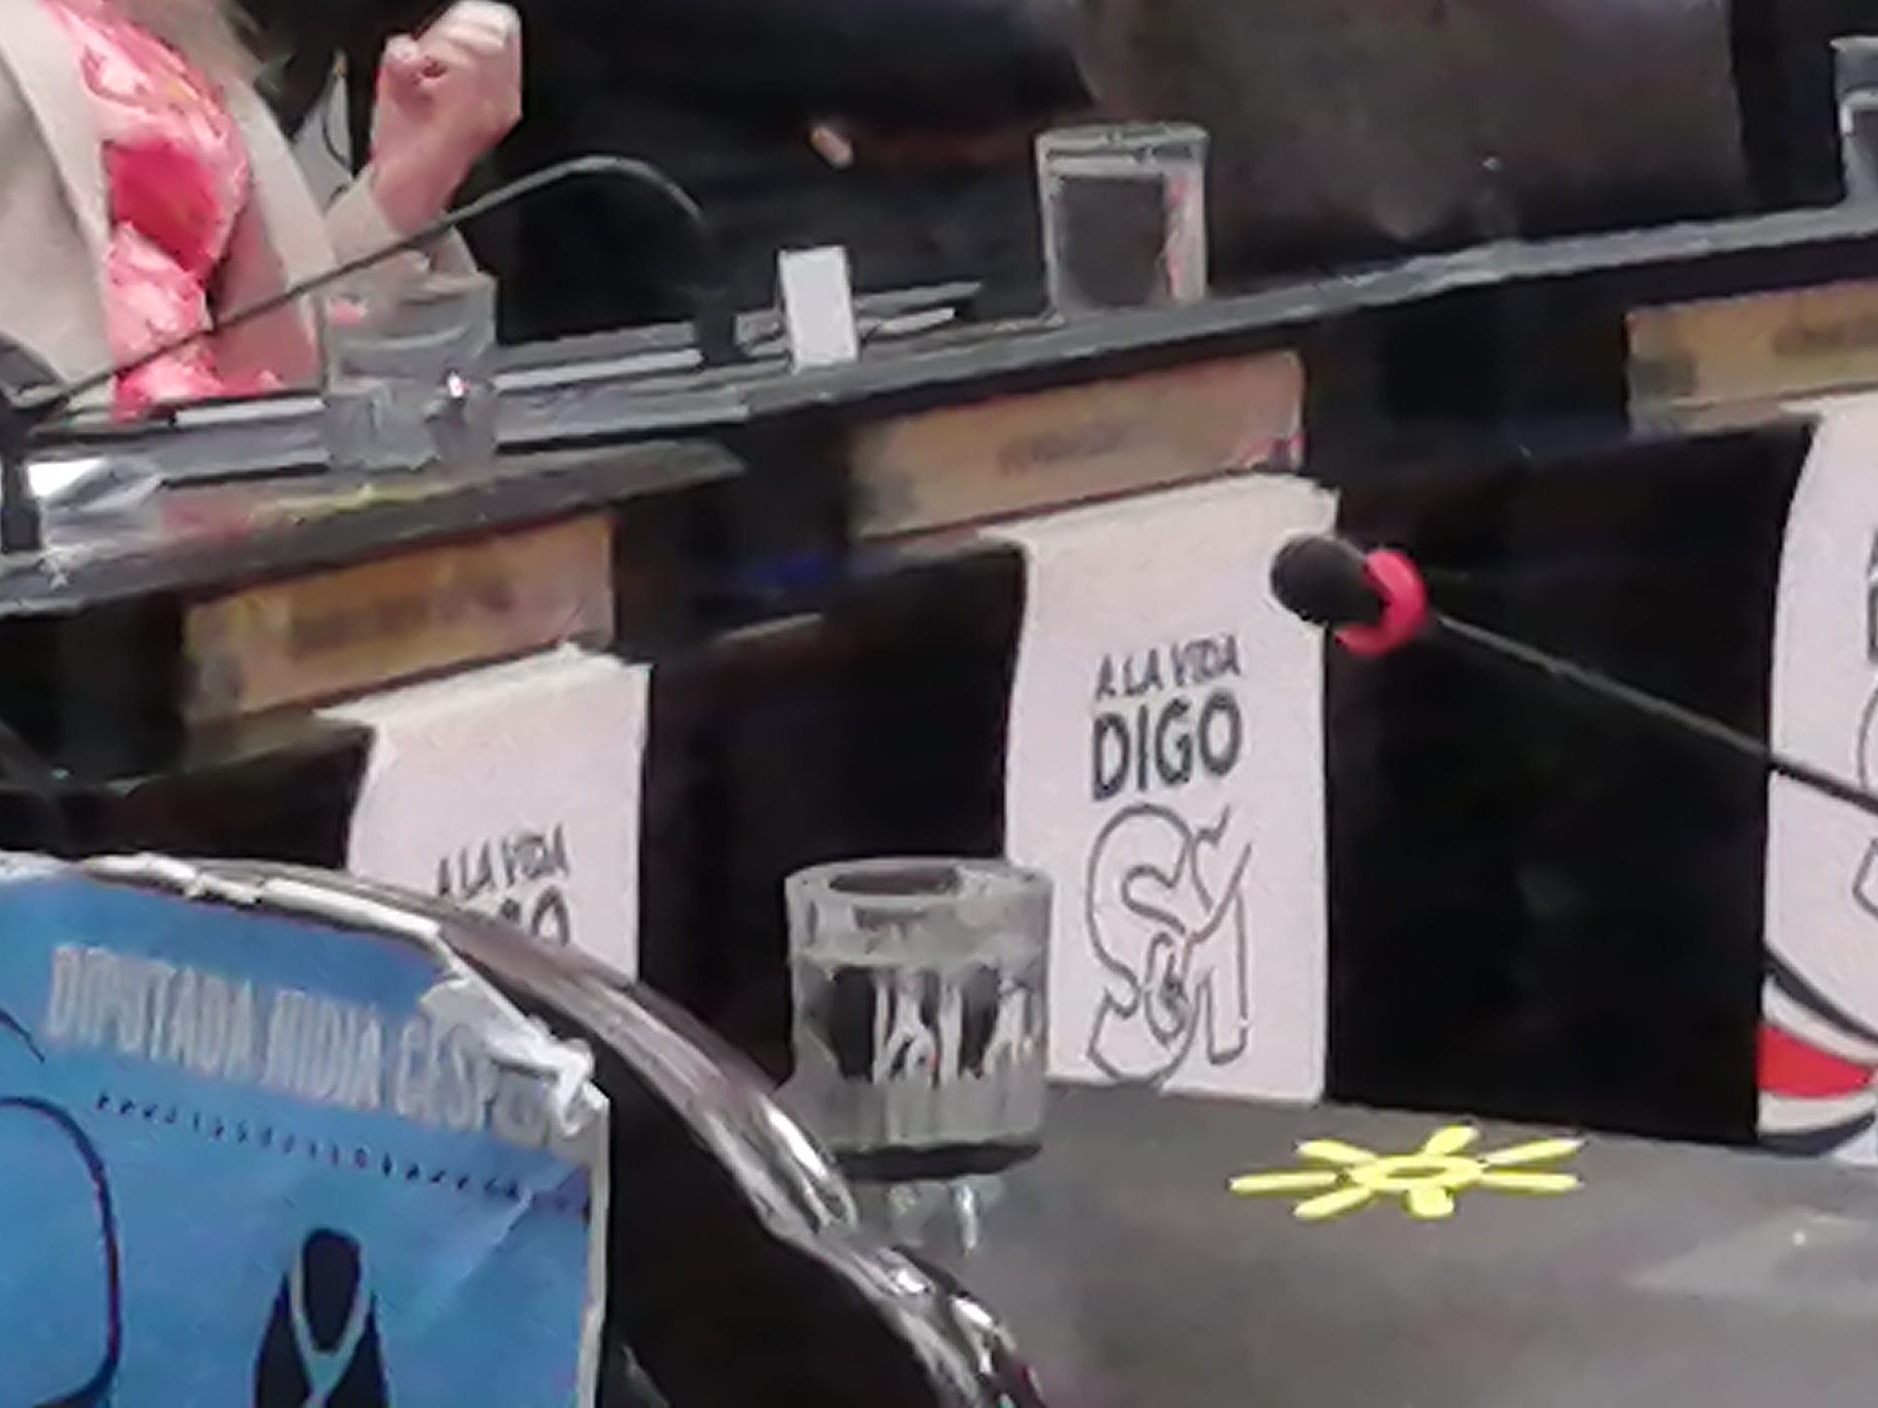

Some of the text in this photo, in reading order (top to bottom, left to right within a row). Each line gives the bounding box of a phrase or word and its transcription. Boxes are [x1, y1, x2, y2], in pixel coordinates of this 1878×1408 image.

[1096, 653, 1117, 701] A
[1124, 647, 1164, 697] LA
[1092, 688, 1242, 801] DIGO
